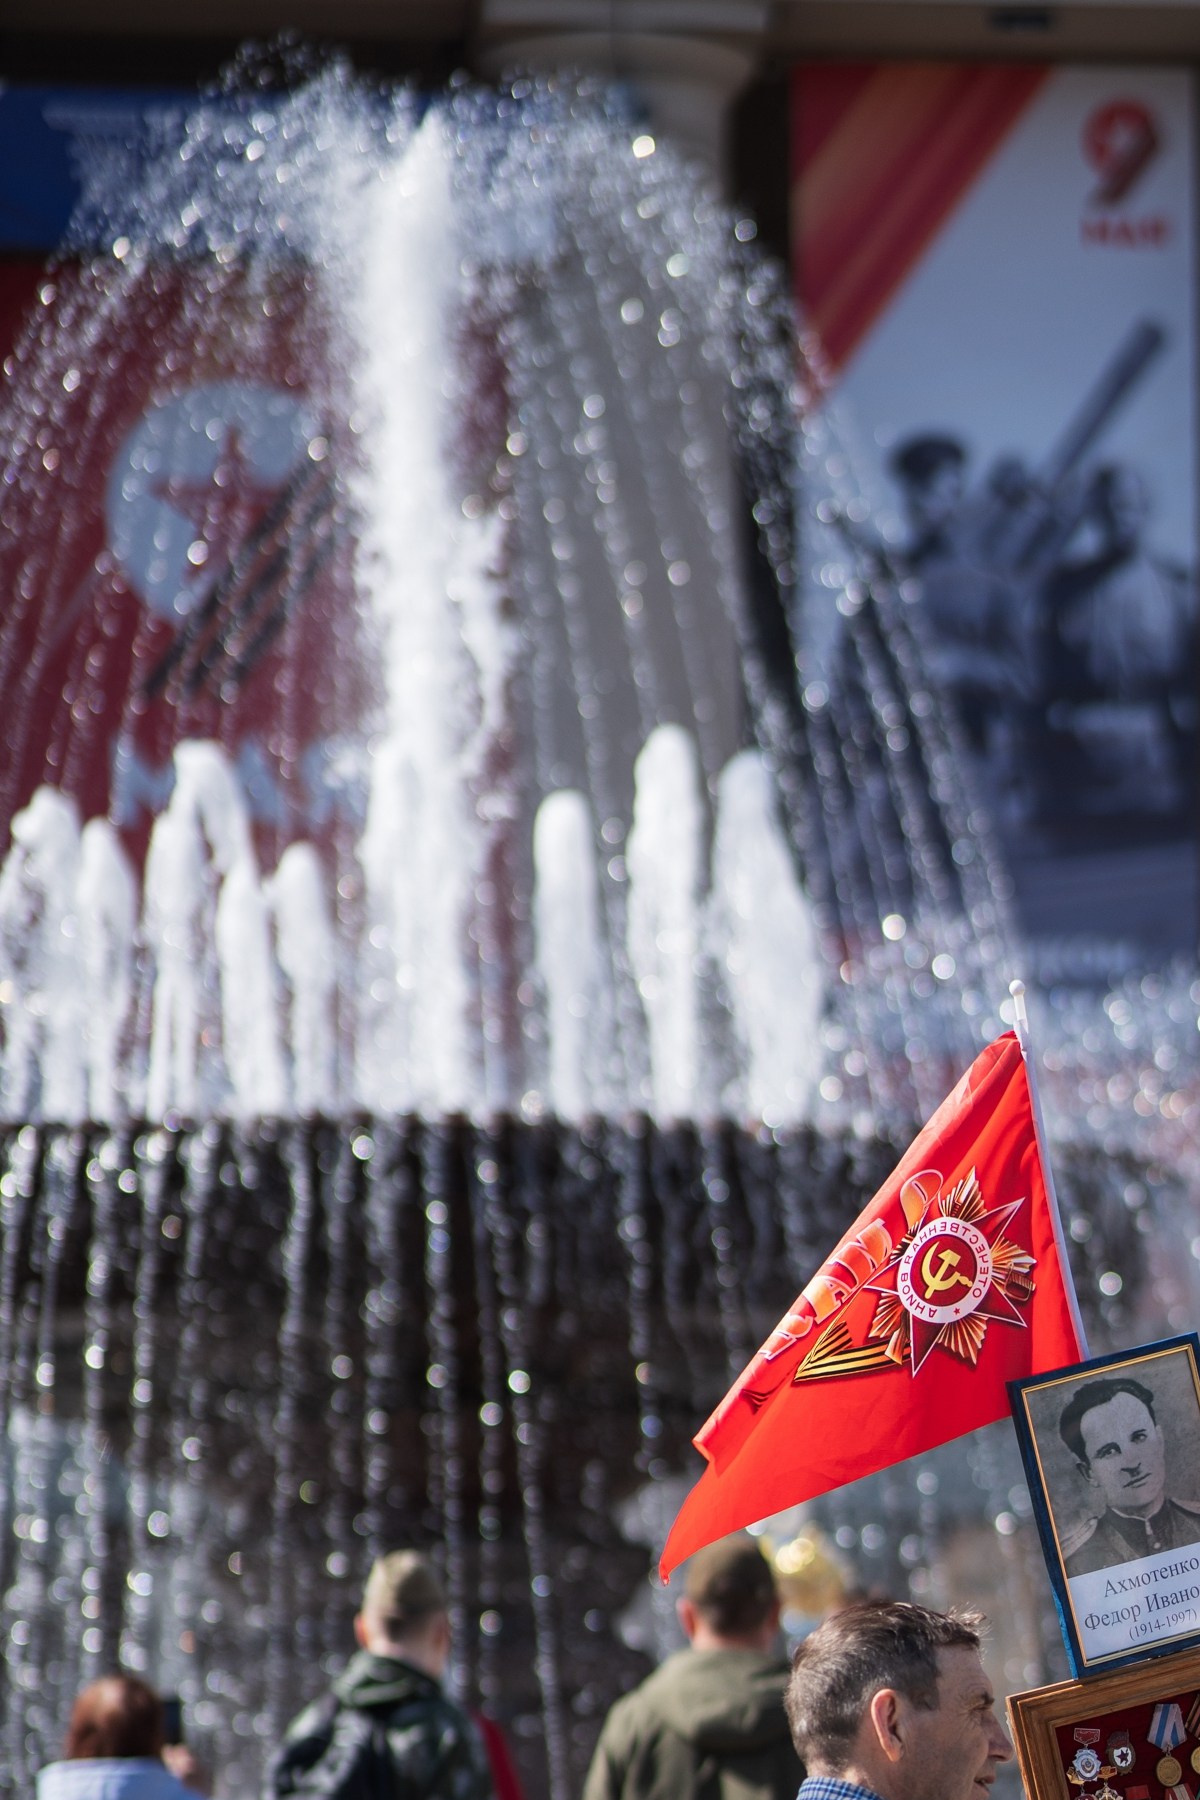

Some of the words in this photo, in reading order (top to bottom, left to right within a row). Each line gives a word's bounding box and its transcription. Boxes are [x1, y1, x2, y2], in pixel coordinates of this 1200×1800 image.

[1081, 98, 1163, 210] 9
[1104, 1557, 1200, 1598] Ахмотенко
[1084, 1603, 1141, 1631] Федор
[1129, 1608, 1198, 1641] (1914-1997)
